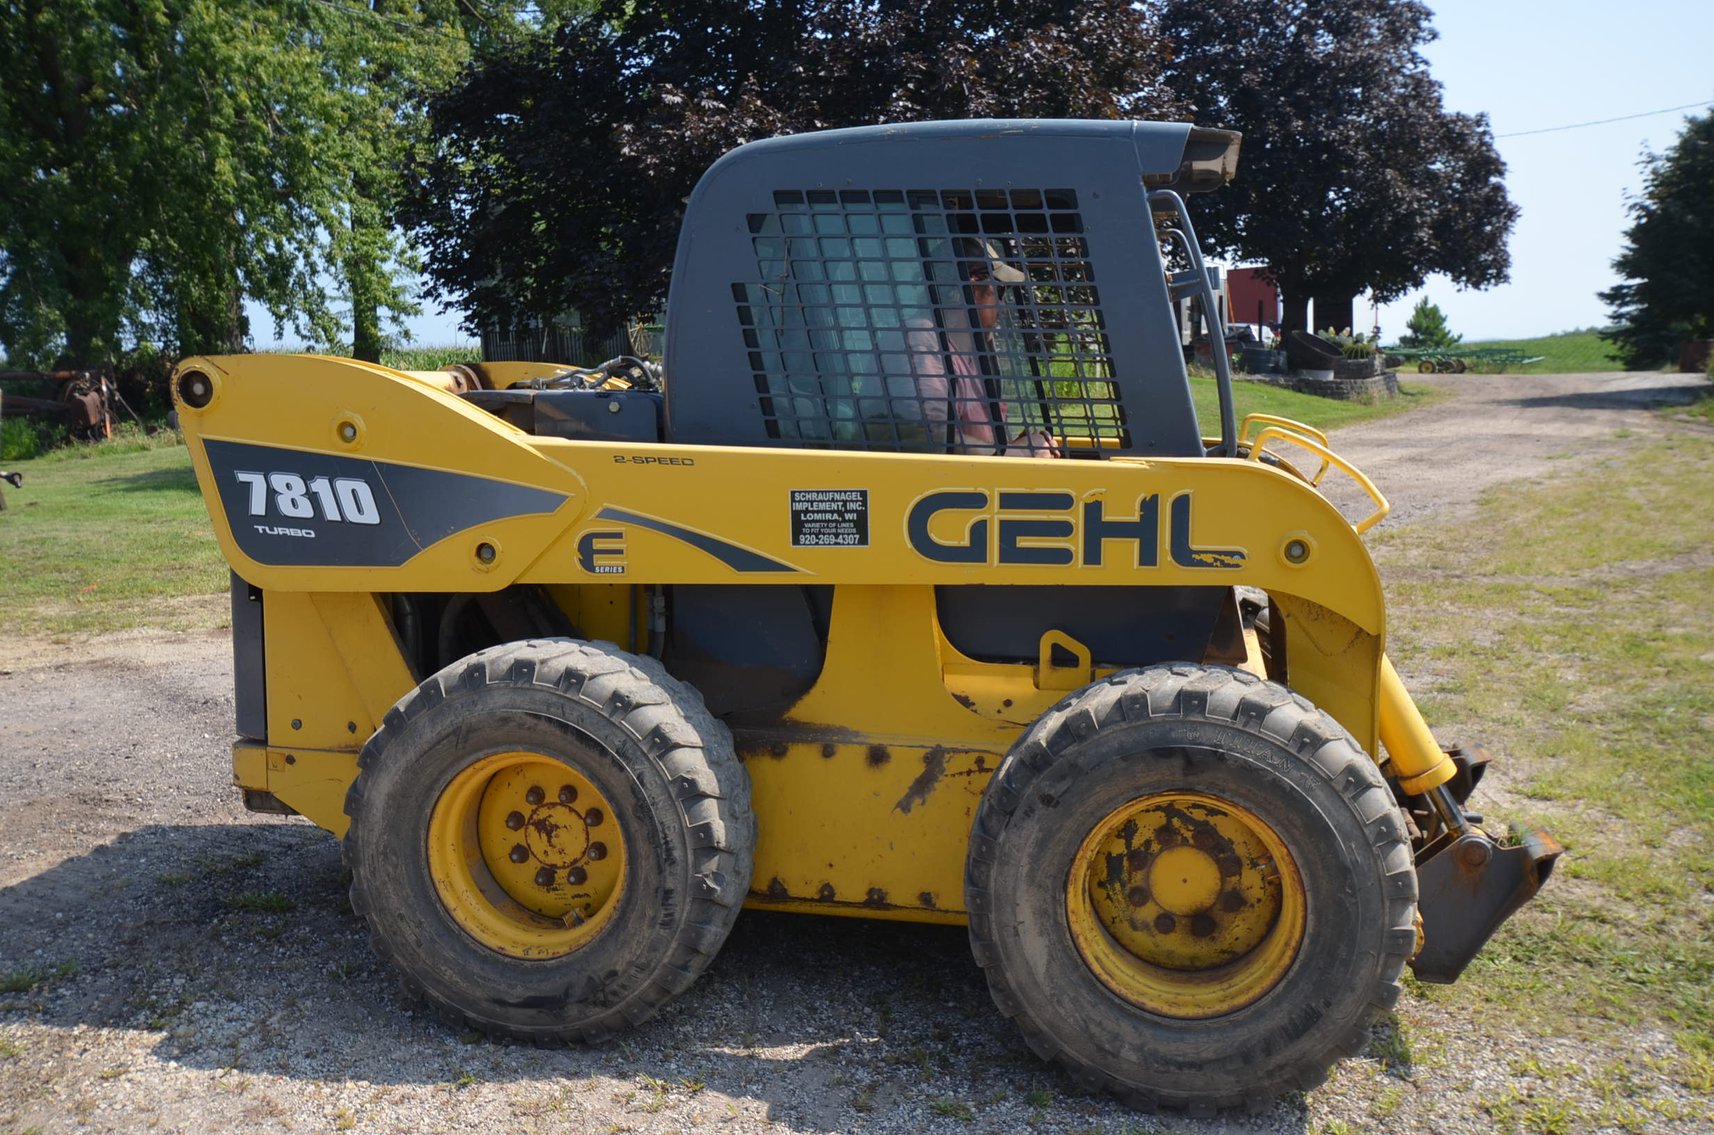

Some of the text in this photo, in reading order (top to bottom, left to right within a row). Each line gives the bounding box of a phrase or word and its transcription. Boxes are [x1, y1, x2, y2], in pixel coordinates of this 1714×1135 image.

[613, 455, 695, 466] 2-SPEED
[234, 470, 381, 525] 7810
[794, 492, 862, 500] SCHRAUFNAGEL
[792, 501, 865, 512] IMPLEMENT, INC.
[801, 513, 842, 521] LOMIRA,
[254, 525, 316, 538] TURBO
[905, 489, 1248, 568] GEHL
[799, 534, 860, 544] 920-269-4307
